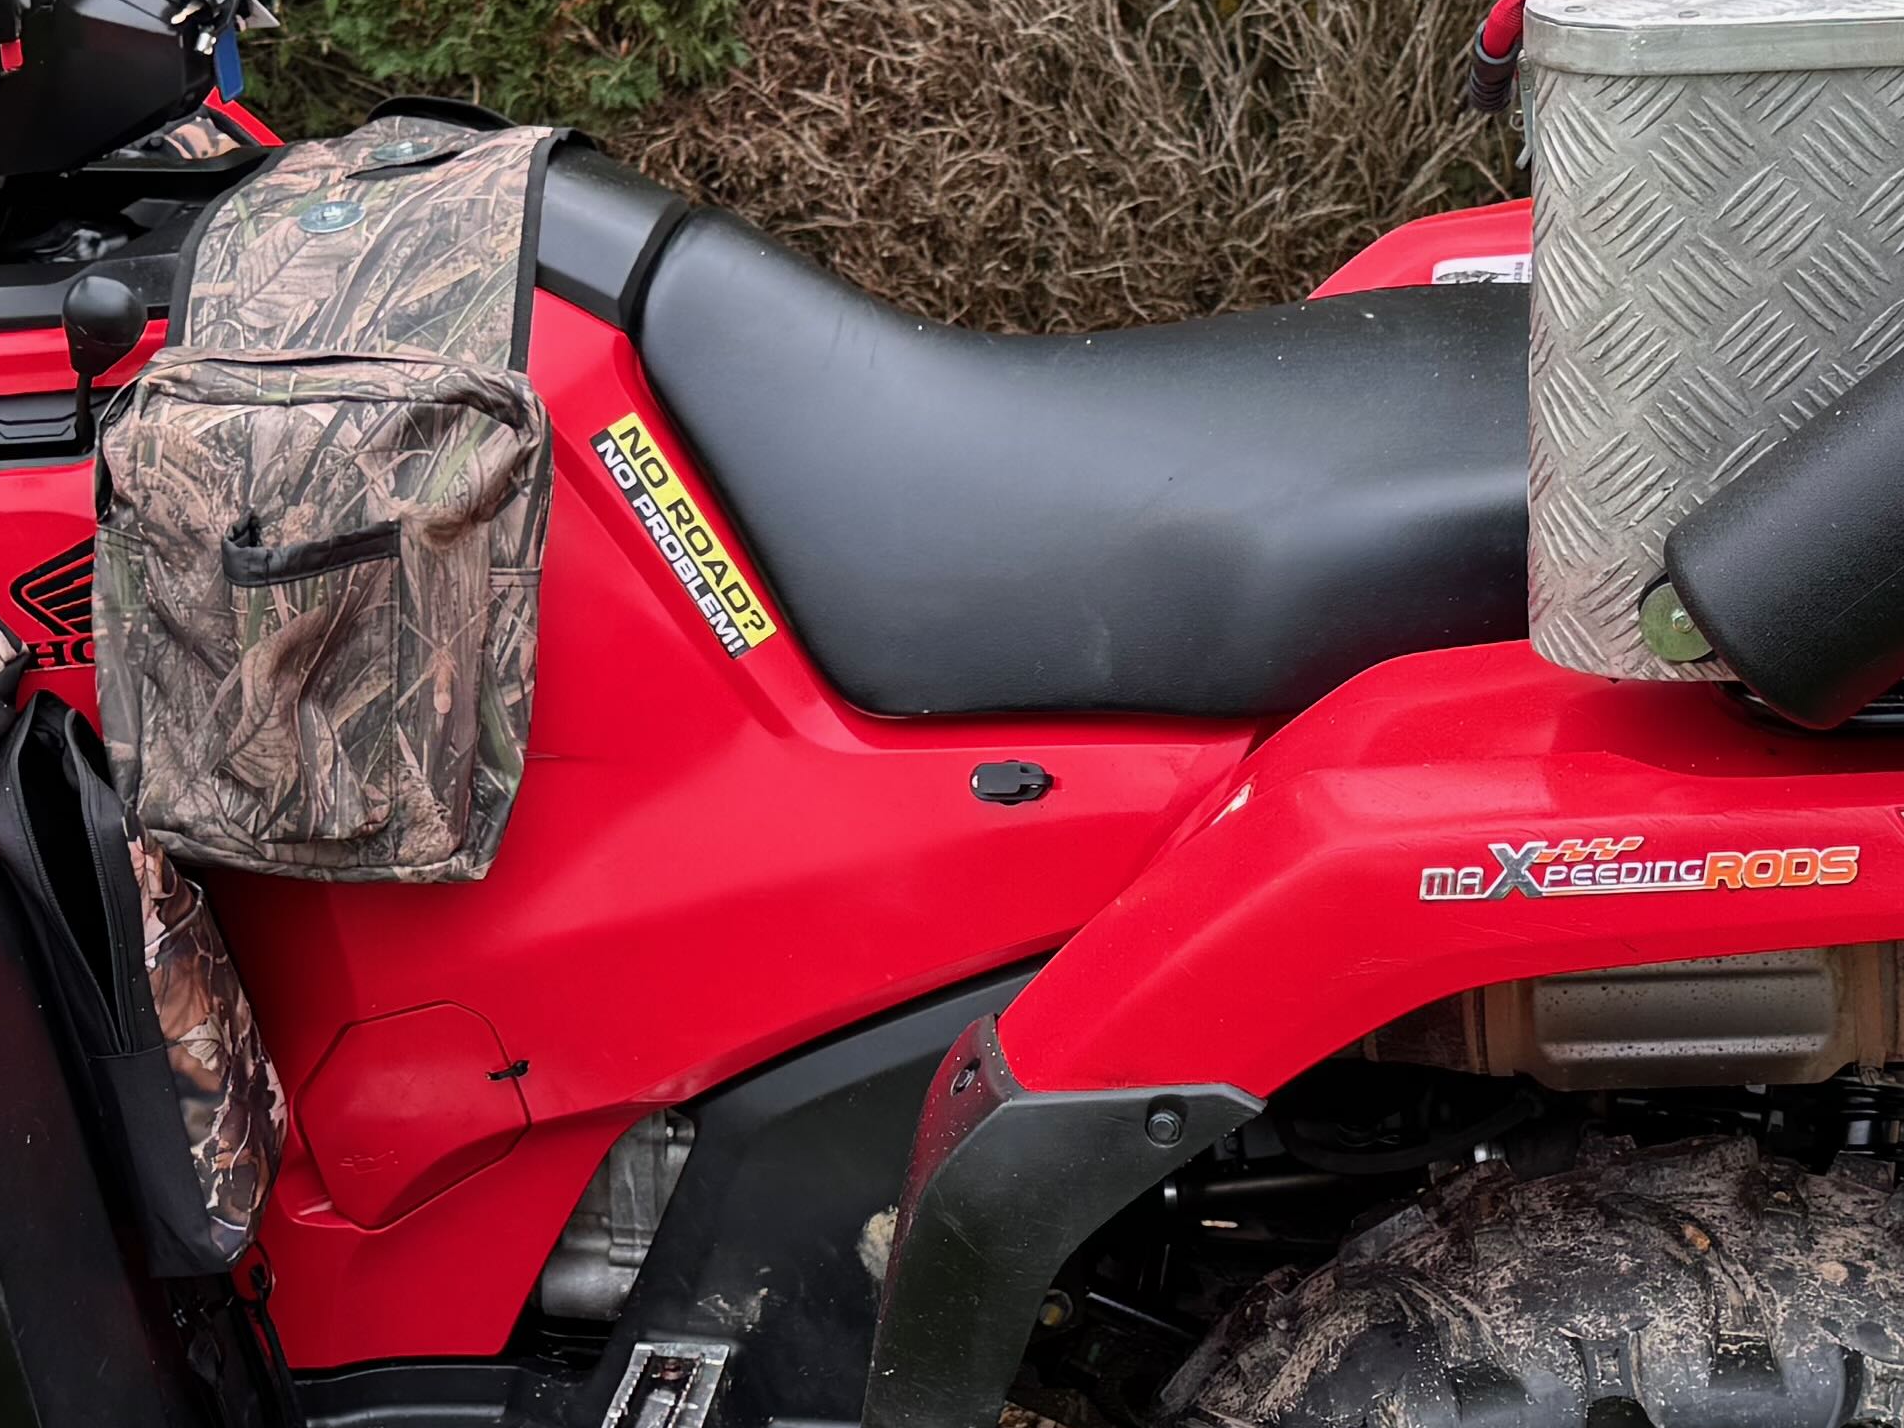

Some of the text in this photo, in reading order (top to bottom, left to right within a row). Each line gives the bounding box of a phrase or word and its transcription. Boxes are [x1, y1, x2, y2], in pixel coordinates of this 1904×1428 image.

[596, 438, 746, 654] NO PROBLEM!
[619, 426, 766, 632] NO ROAD?
